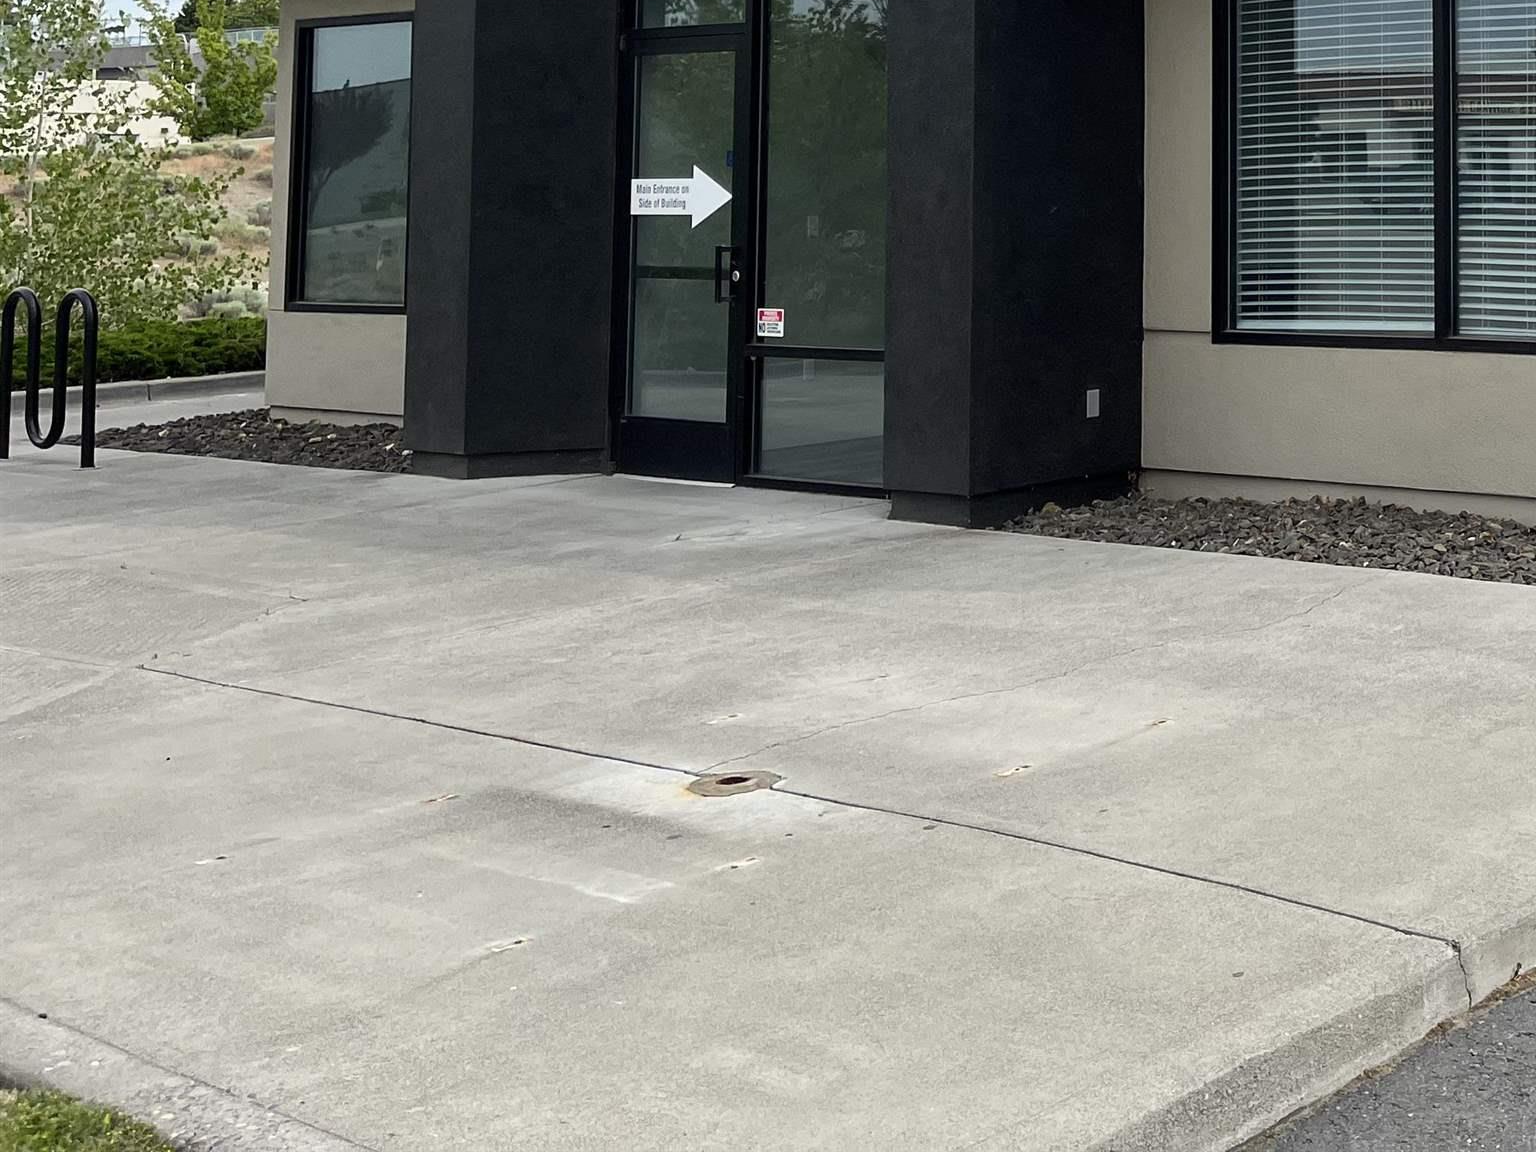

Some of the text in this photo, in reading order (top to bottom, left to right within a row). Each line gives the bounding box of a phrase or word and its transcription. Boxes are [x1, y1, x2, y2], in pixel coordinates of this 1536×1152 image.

[636, 184, 689, 194] Main Entrance on
[639, 198, 686, 210] Side of Building
